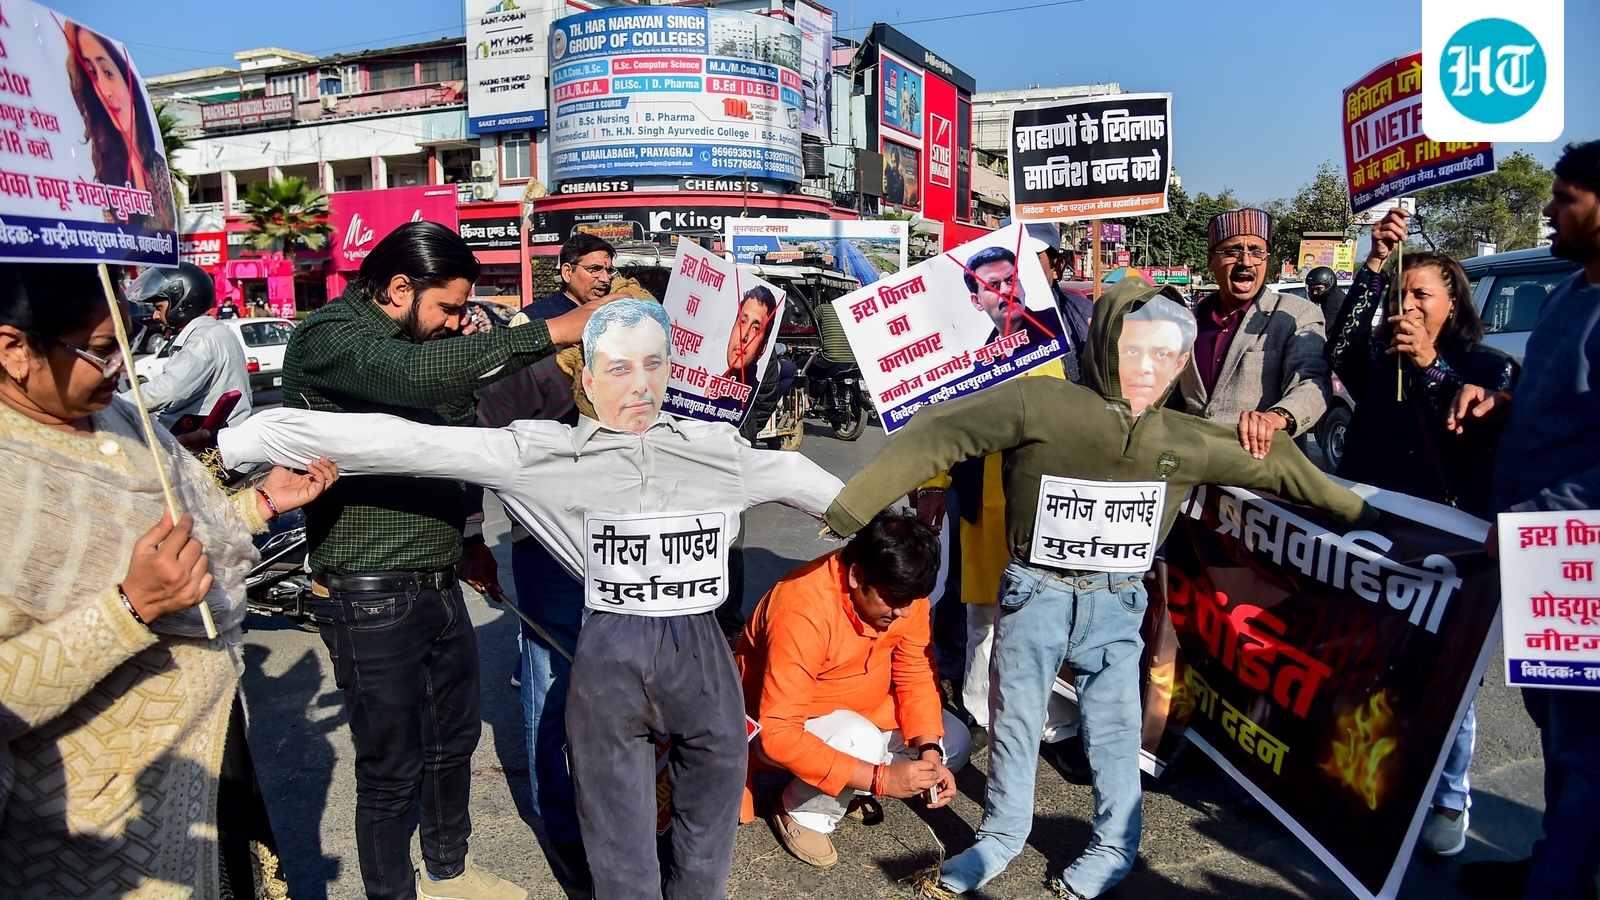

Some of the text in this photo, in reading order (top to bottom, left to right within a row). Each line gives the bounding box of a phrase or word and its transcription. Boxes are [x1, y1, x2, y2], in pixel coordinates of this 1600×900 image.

[481, 12, 526, 26] SAINT-GOBAIN
[569, 15, 704, 37] TH. HAR NARAYAN SINGH
[491, 34, 533, 48] MY HOME
[569, 35, 607, 54] GROUP
[610, 33, 628, 48] OF
[632, 32, 706, 47] COLLEGES
[614, 60, 700, 70] B.Sc. Computer Science
[479, 74, 530, 86] MAKING THE WORLD
[490, 85, 510, 93] BETTER
[511, 82, 525, 91] HOME
[652, 79, 699, 89] D. Pharma
[713, 80, 736, 92] B.Ed
[225, 103, 239, 117] PEST
[239, 99, 265, 116] CONTROL
[264, 96, 293, 113] SERVICES
[576, 102, 595, 112] COLLEGE
[595, 101, 600, 109] &
[601, 100, 622, 108] COURSE
[750, 103, 777, 112] SCHOLARSHIP
[1347, 76, 1393, 123] डिजिटल
[28, 106, 61, 134] शेख
[478, 116, 534, 128] SAKET ADVERTISING
[579, 114, 630, 126] B.Sc Nursing
[645, 113, 695, 122] B. Pharma
[1080, 113, 1099, 145] के
[1102, 109, 1165, 144] खिलाफ
[556, 130, 589, 144] Paramedical
[601, 126, 750, 138] Th. H.N. Singh Ayurvedic College
[761, 130, 778, 142] B.Sc.
[26, 137, 54, 160] करो
[582, 147, 693, 161] KARAILABAGH, PRAYAGRAJ
[712, 147, 763, 160] 9696938315,
[712, 158, 763, 172] 8115776826,
[1023, 149, 1161, 191] साजिश बन्द करो
[1353, 164, 1365, 188] को
[1367, 159, 1380, 181] बंद
[1382, 146, 1410, 174] करो,
[1415, 139, 1440, 163] FIR
[561, 181, 629, 194] CHEMISTS
[684, 180, 759, 192] CHEMISTS
[1390, 173, 1416, 191] परशुराम
[1417, 168, 1437, 182] सेना,
[34, 175, 73, 212] कपूर
[73, 175, 109, 210] शेख
[107, 178, 155, 221] मुर्दाबाद
[1022, 206, 1044, 215] निवेदक
[1070, 203, 1096, 213] परशुराम
[1097, 200, 1112, 209] सेना
[40, 221, 79, 250] राष्ट्रीय
[78, 229, 119, 255] परशुराम
[118, 226, 139, 252] सेना,
[343, 213, 374, 250] Mia
[460, 221, 520, 239] किंग्स एण्ड कं.
[577, 224, 634, 238] Panther
[733, 225, 789, 234] सुपरफास्ट रफ्तार
[742, 244, 768, 252] एक्सप्रेसवे
[680, 253, 726, 293] इस फिल्म
[686, 293, 701, 317] का
[849, 275, 927, 323] इस फिल्म
[886, 314, 911, 337] का
[877, 332, 943, 374] कलाकार
[879, 329, 1030, 404] मनोज बाजपेई मुर्दाबाद
[955, 368, 993, 391] परशुराम
[992, 358, 1015, 377] सेना,
[687, 365, 709, 389] पांडे
[709, 374, 753, 403] मुर्दाबाद
[683, 398, 704, 414] परशुराम
[704, 400, 717, 417] सेना,
[1046, 489, 1097, 521] मनोज
[1105, 490, 1157, 526] वाजपेई
[592, 518, 720, 566] नीरज पाण्डेय
[1518, 526, 1557, 548] इस
[1041, 536, 1150, 560] मुर्दाबाद
[1561, 561, 1593, 582] का
[594, 575, 721, 605] मुर्दाबाद
[1194, 591, 1332, 719] पंडित
[1222, 699, 1290, 776] दहन
